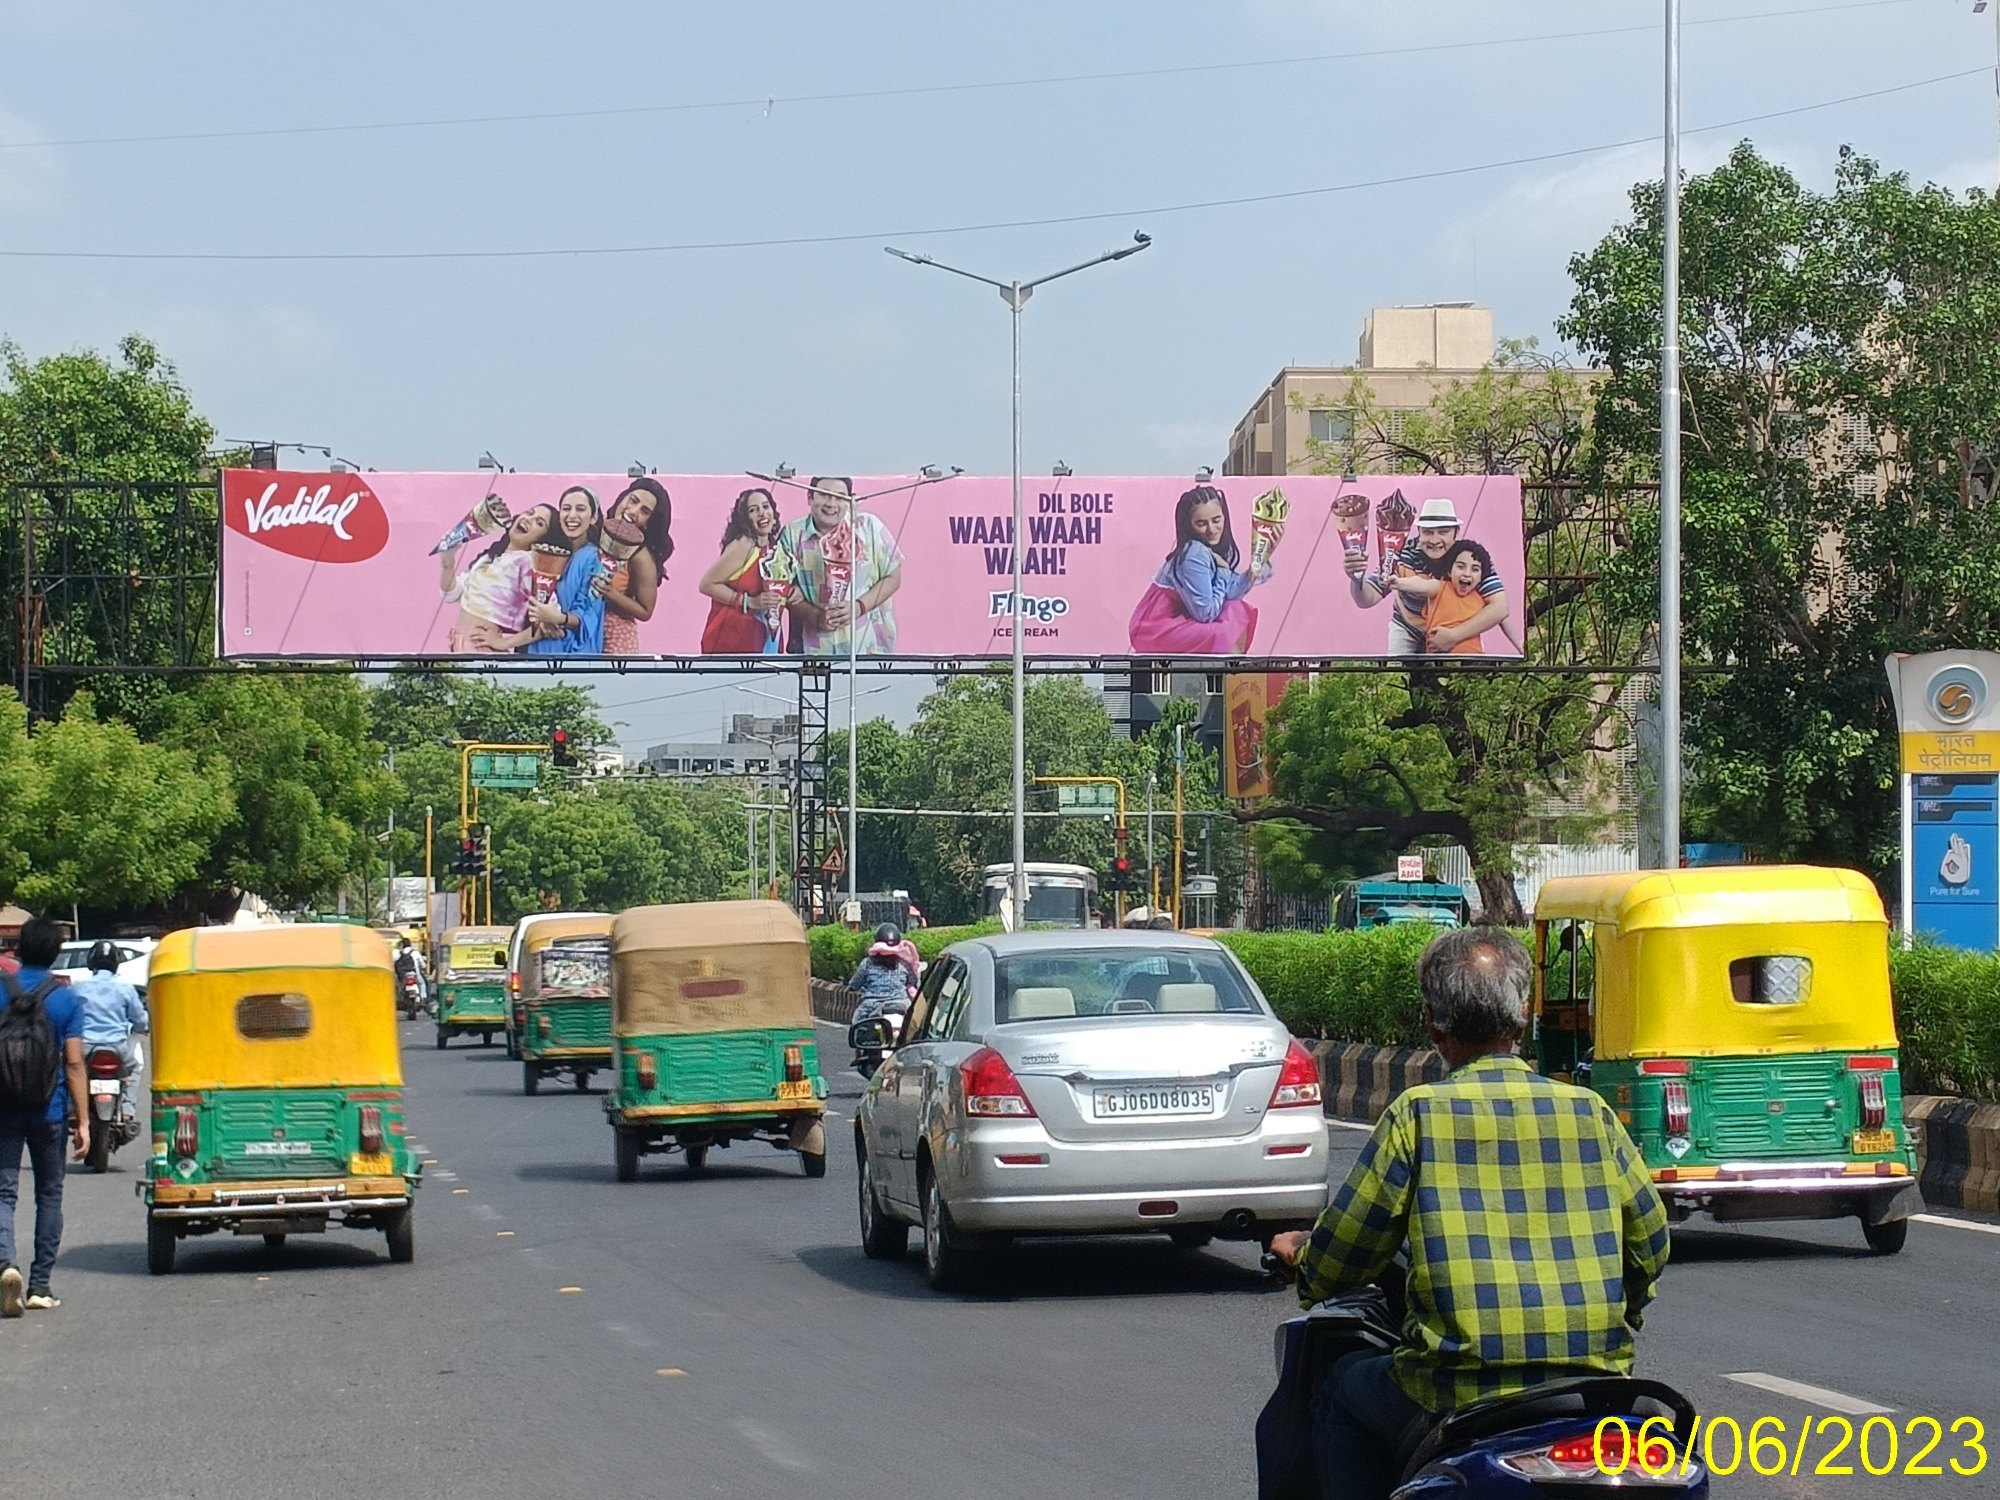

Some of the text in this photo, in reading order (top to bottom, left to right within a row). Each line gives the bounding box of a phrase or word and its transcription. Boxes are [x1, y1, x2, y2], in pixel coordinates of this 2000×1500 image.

[245, 482, 359, 540] Vadilal
[1039, 493, 1113, 513] DIL BOLE
[1028, 516, 1101, 544] WAAH
[991, 591, 1067, 622] Flngo
[993, 627, 1059, 637] ICE REAM
[1935, 734, 1977, 748] भारत
[1918, 747, 1992, 770] पेट्रोलियम
[1929, 886, 1948, 896] Pure
[1961, 886, 1980, 896] Sure
